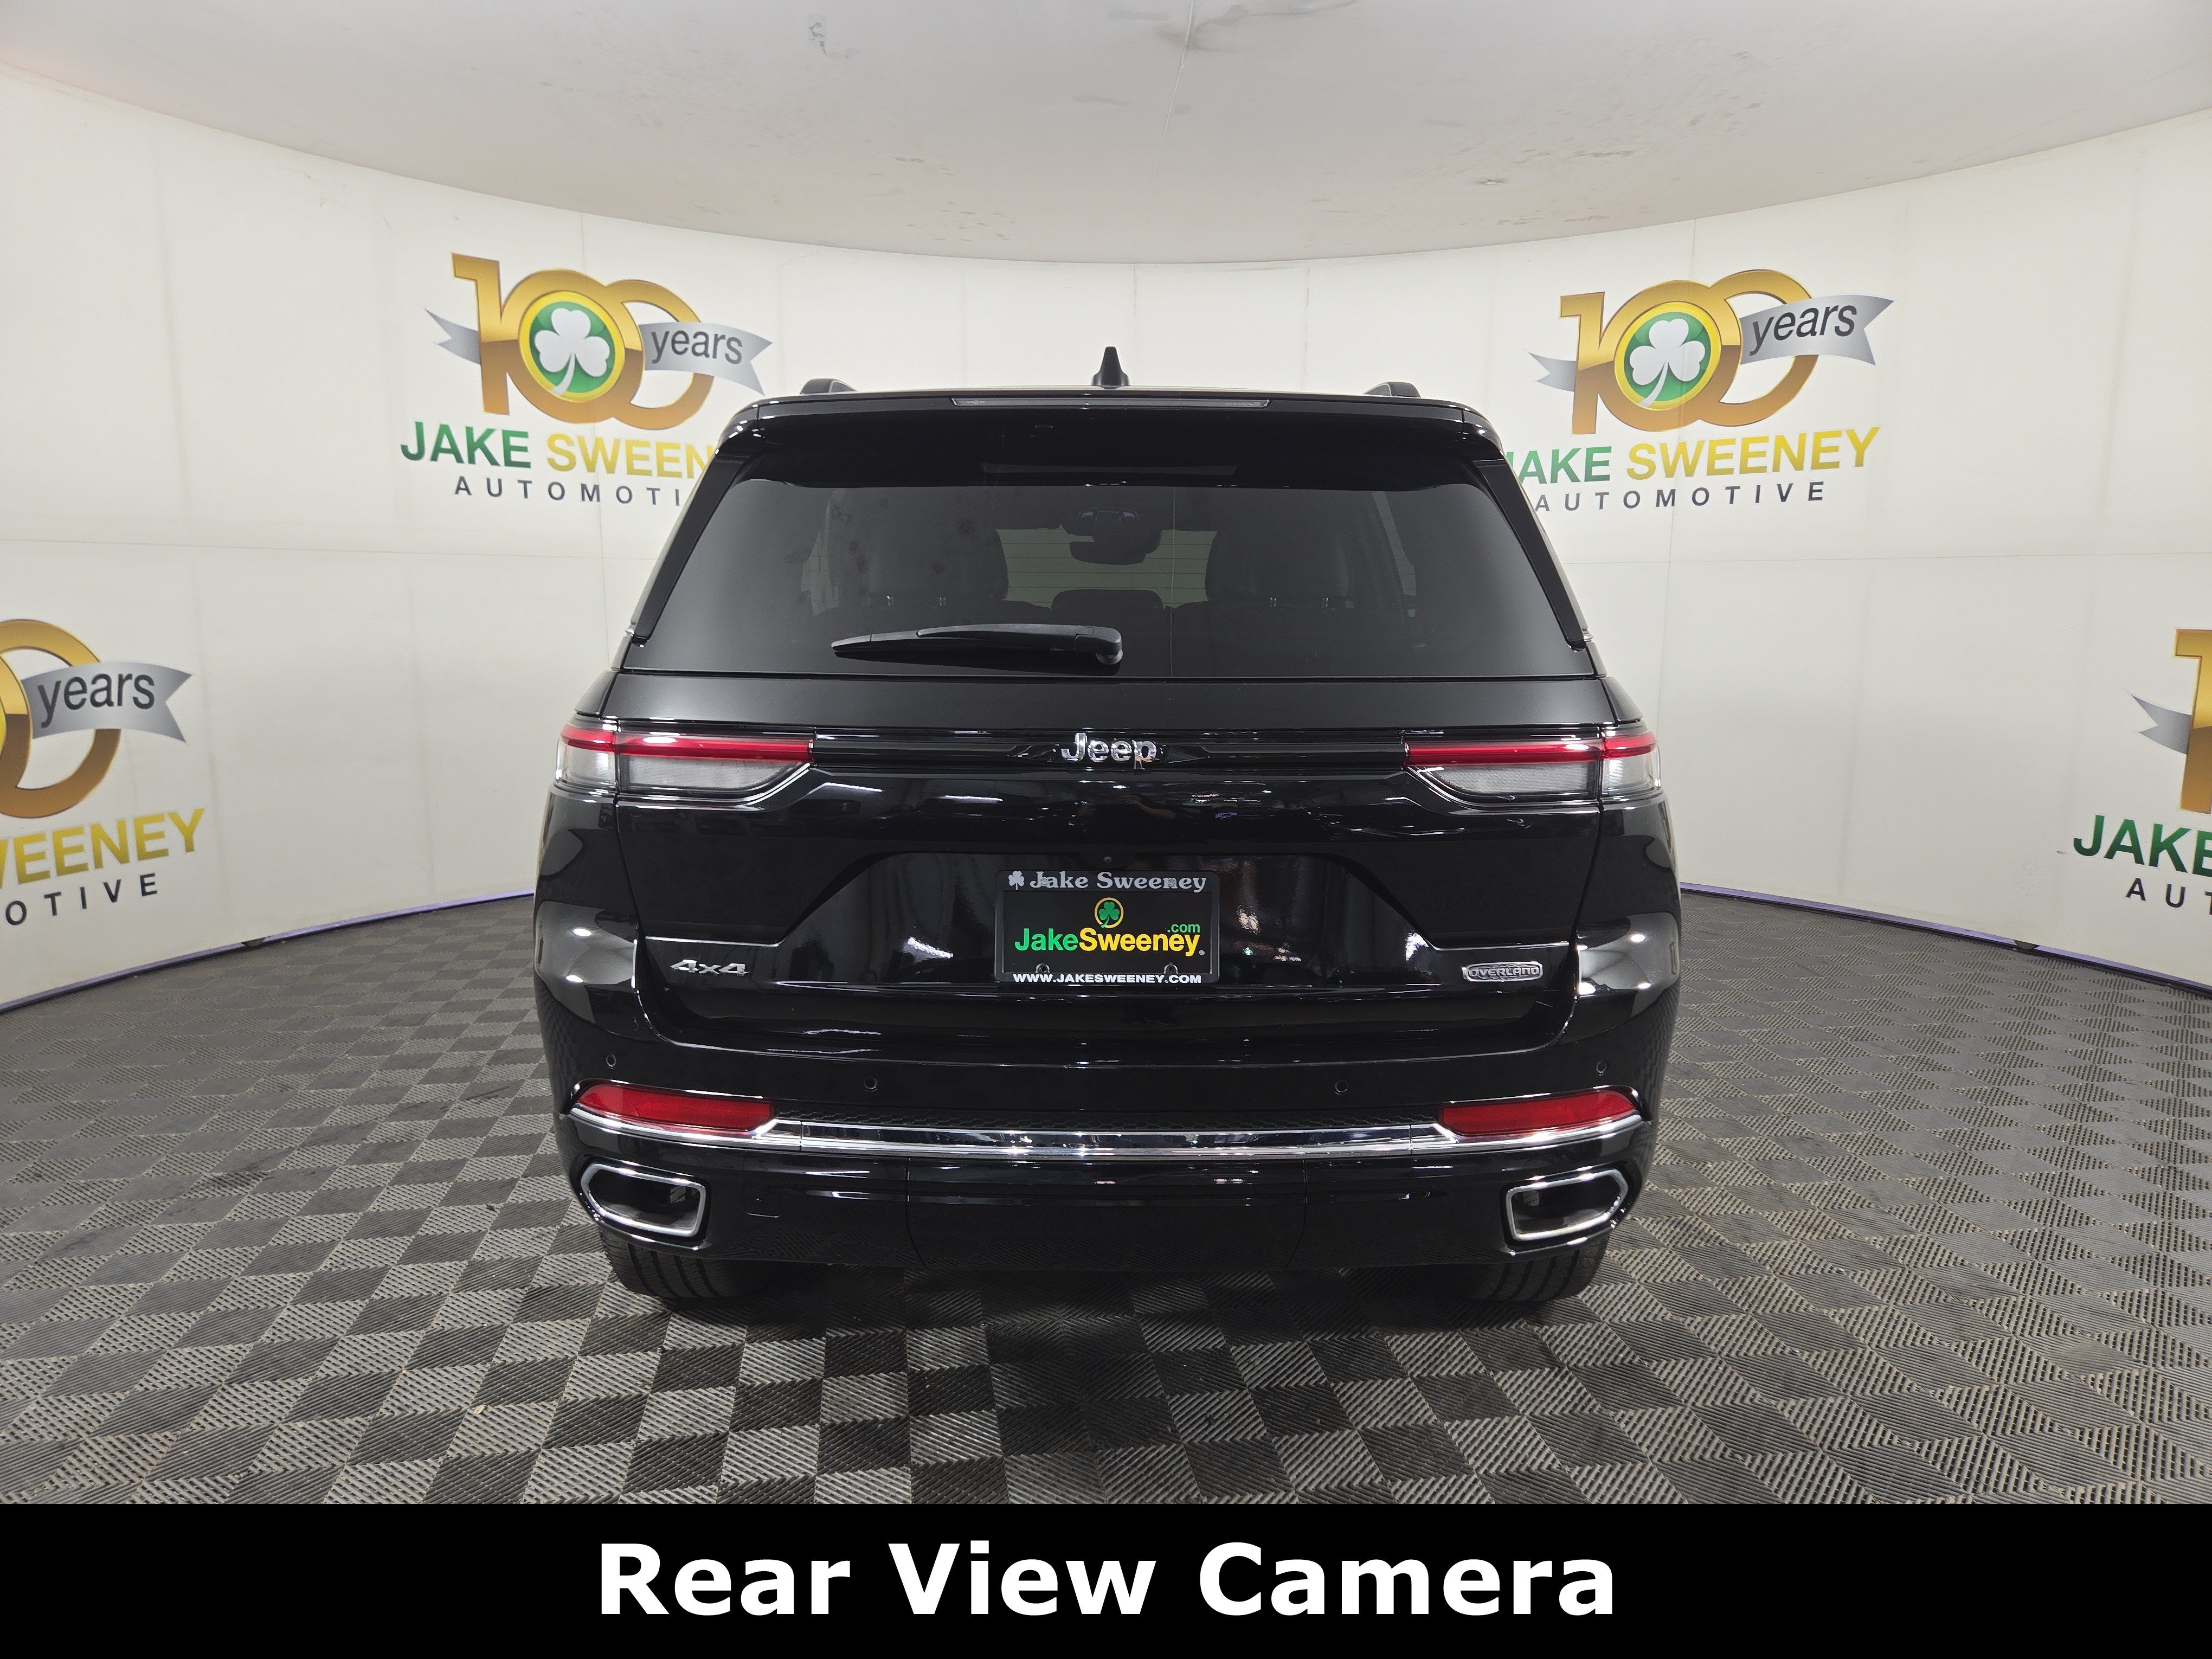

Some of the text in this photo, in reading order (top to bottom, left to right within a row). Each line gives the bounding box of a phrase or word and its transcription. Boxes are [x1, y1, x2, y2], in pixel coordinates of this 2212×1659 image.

[452, 253, 743, 430] 100 years
[1559, 269, 1857, 435] 100 years
[401, 420, 531, 469] JAKE
[1626, 426, 1881, 480] SWEENEY
[454, 476, 680, 507] AUTOMOTI
[1535, 481, 1824, 512] AUTOMOTIVE
[0, 619, 156, 819] 0 years
[1061, 732, 1157, 769] Jeep
[0, 808, 205, 889] EENEY
[2073, 814, 2212, 878] JAKE
[1030, 871, 1207, 893] Jake Sweeney
[1014, 927, 1200, 956] JakeSweeney
[1167, 922, 1200, 933] .com
[670, 959, 750, 976] 4x4
[1013, 974, 1201, 983] WWW.JAKESWEENEY.COM
[1468, 967, 1540, 977] OVERLAND
